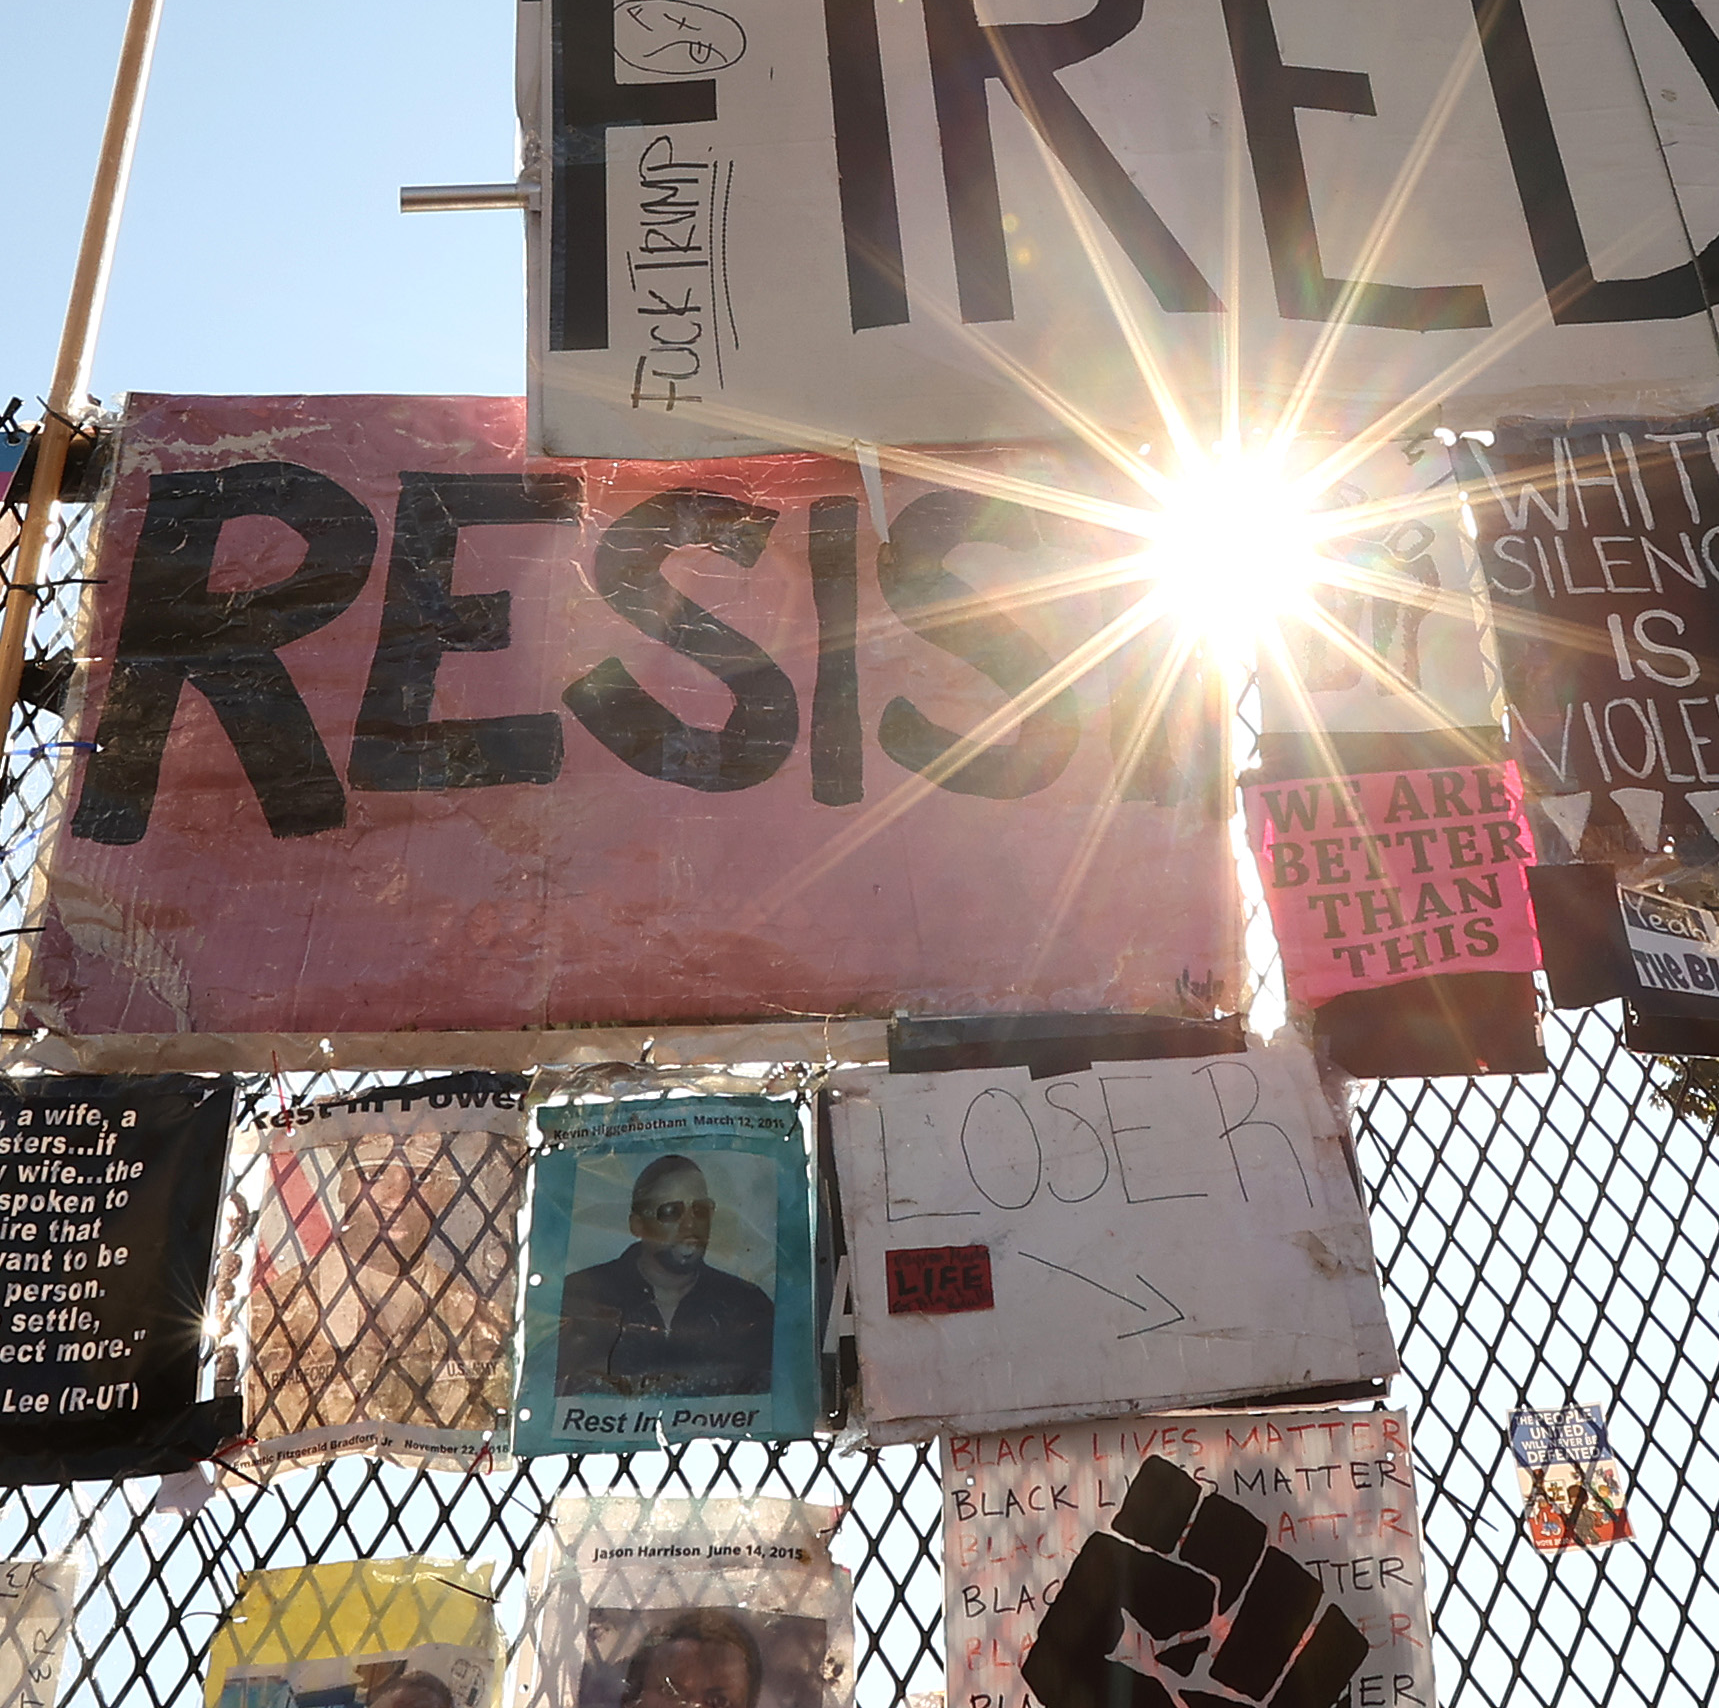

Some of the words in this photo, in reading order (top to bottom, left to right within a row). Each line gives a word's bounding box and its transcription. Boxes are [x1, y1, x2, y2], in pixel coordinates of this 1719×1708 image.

[630, 288, 703, 411] FUCK
[71, 460, 1080, 846] RESIS
[1607, 609, 1701, 688] IS
[1261, 776, 1362, 834] WE
[1387, 767, 1515, 820] ARE
[1268, 819, 1532, 888] BETTER
[1308, 872, 1502, 940] THAN
[1624, 893, 1707, 941] Yeah
[1333, 916, 1500, 978] THIS
[879, 1061, 1313, 1222] LOSER
[104, 1187, 129, 1209] to
[48, 1217, 102, 1243] that
[4, 1277, 106, 1308] person.
[895, 1264, 982, 1296] LIFE
[2, 1387, 50, 1413] Lee
[59, 1382, 140, 1414] (R-UT)
[561, 1406, 629, 1433] Rest
[632, 1406, 656, 1434] In
[671, 1405, 759, 1431] Power
[950, 1433, 1070, 1472] BLACK
[1092, 1425, 1205, 1462] LIVES
[1225, 1419, 1410, 1454] MATTER
[593, 1543, 633, 1563] Jason
[637, 1542, 701, 1559] Harrison
[707, 1542, 741, 1560] June
[744, 1543, 766, 1562] 14,
[769, 1545, 803, 1562] 2015
